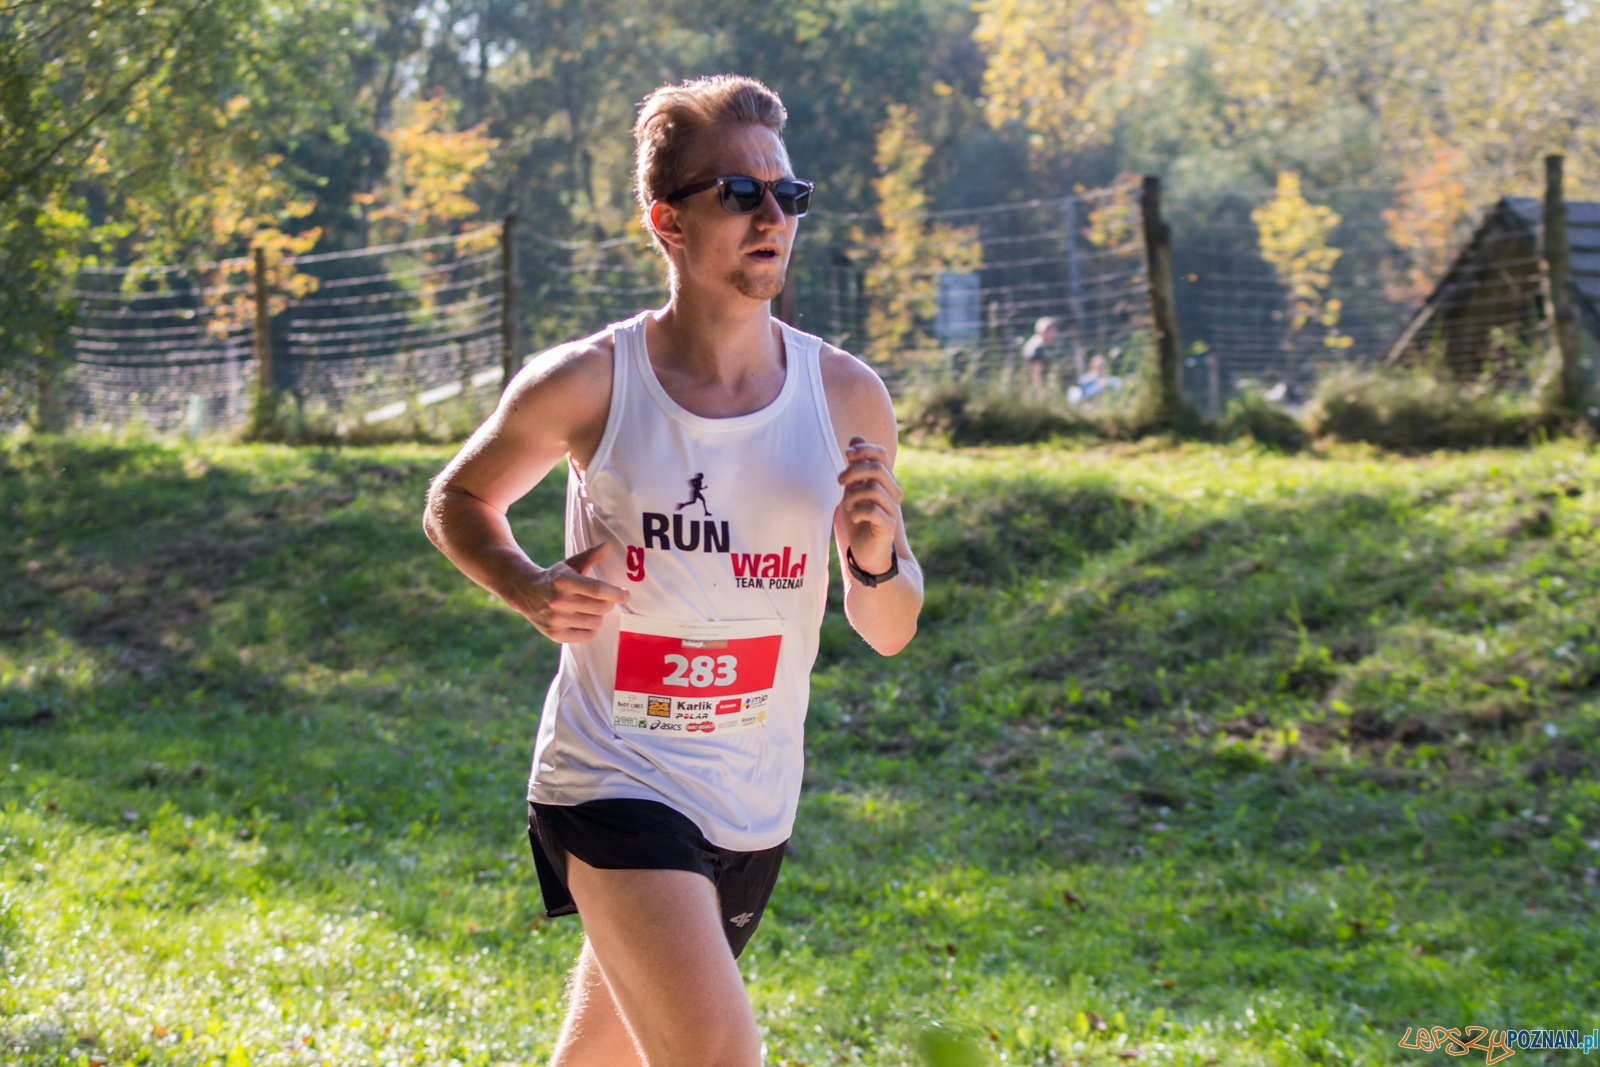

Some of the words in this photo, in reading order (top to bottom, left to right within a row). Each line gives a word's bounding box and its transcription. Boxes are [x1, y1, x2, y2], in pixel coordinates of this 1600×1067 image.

[642, 512, 730, 553] RUN
[662, 654, 738, 688] 283
[649, 701, 670, 712] 24
[677, 701, 712, 711] Karlik
[613, 716, 638, 726] green
[730, 912, 754, 928] 4F
